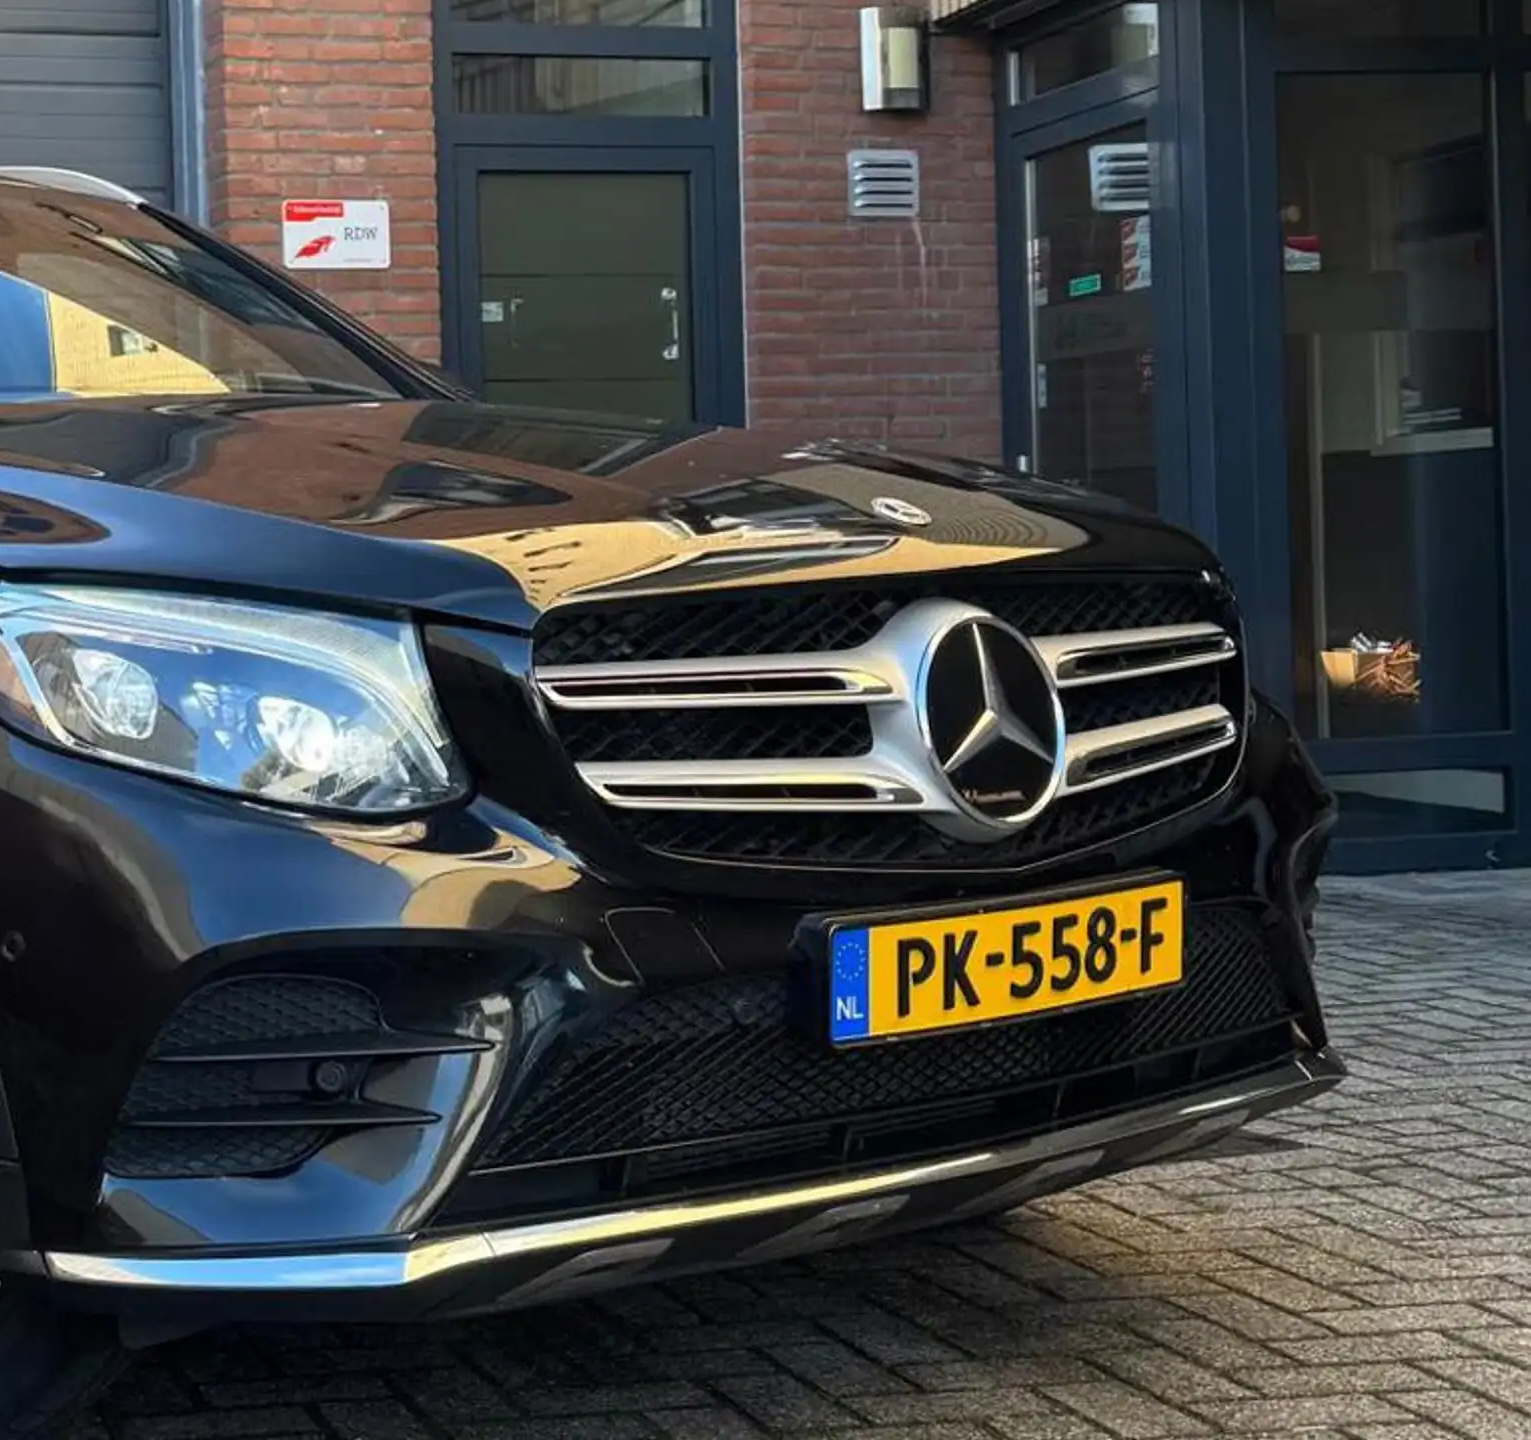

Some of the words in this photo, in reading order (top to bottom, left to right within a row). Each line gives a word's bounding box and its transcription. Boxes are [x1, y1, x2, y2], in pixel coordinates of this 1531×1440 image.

[343, 226, 378, 241] RDW
[896, 896, 1169, 1019] PK-558-F
[835, 995, 864, 1022] NL
